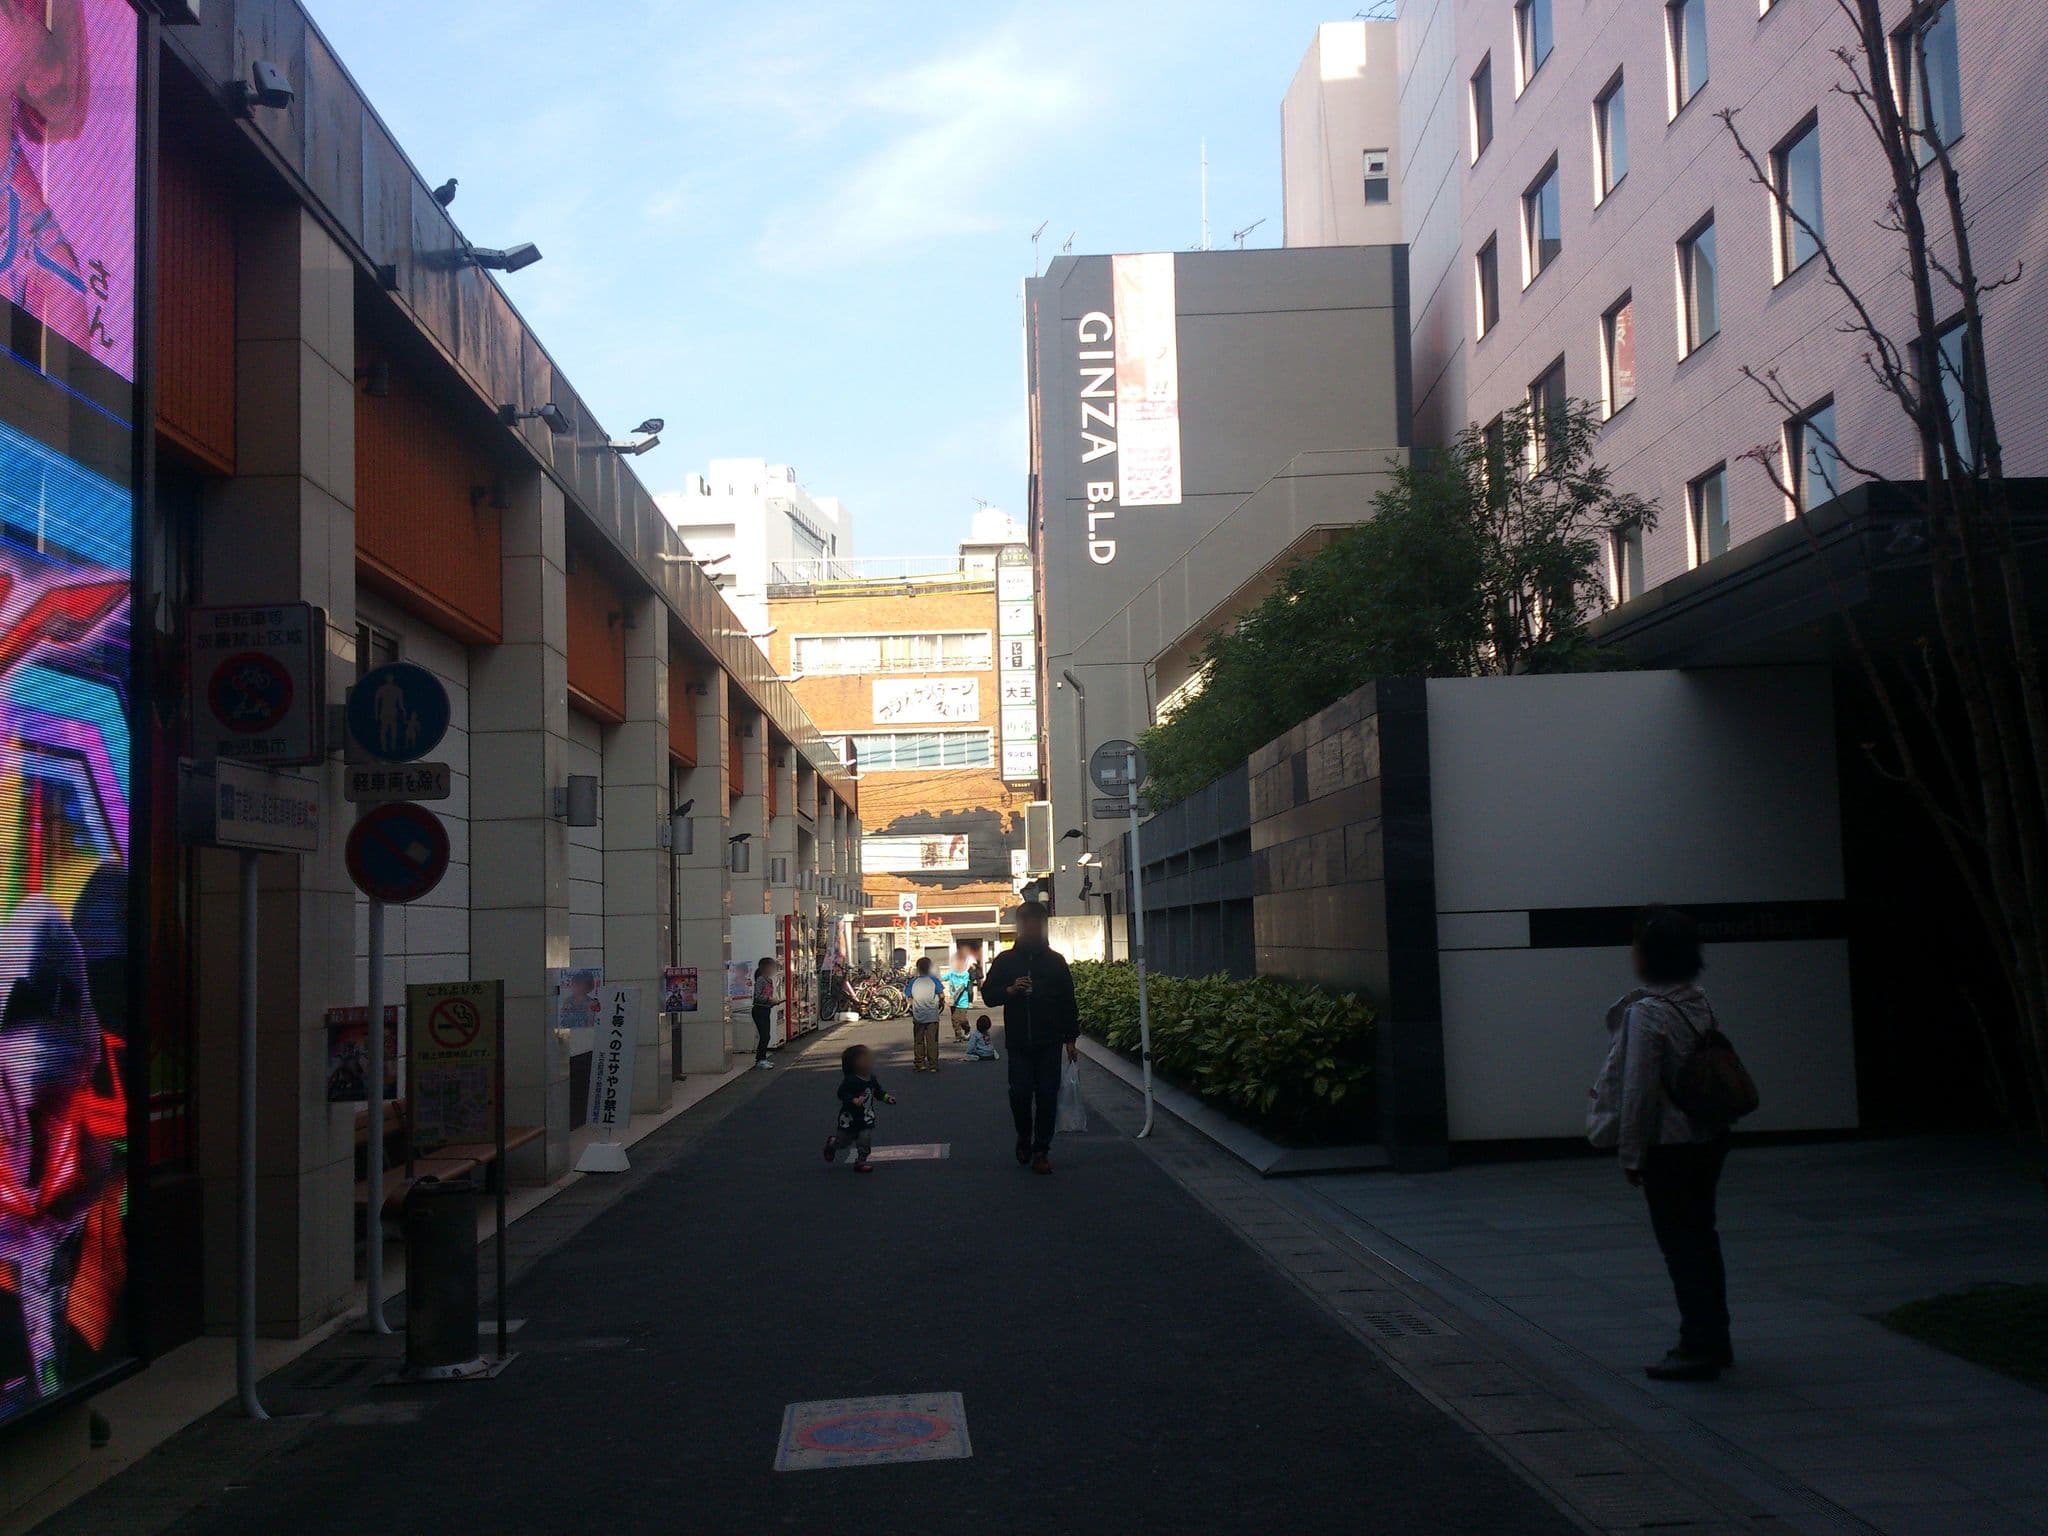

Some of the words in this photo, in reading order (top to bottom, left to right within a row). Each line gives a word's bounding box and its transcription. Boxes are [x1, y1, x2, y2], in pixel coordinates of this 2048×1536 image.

[1078, 311, 1118, 465] GINZA
[1006, 686, 1032, 699] 大王
[351, 770, 444, 794] 軽車両を除く
[602, 990, 626, 1125] ハト等へのエサやり禁止
